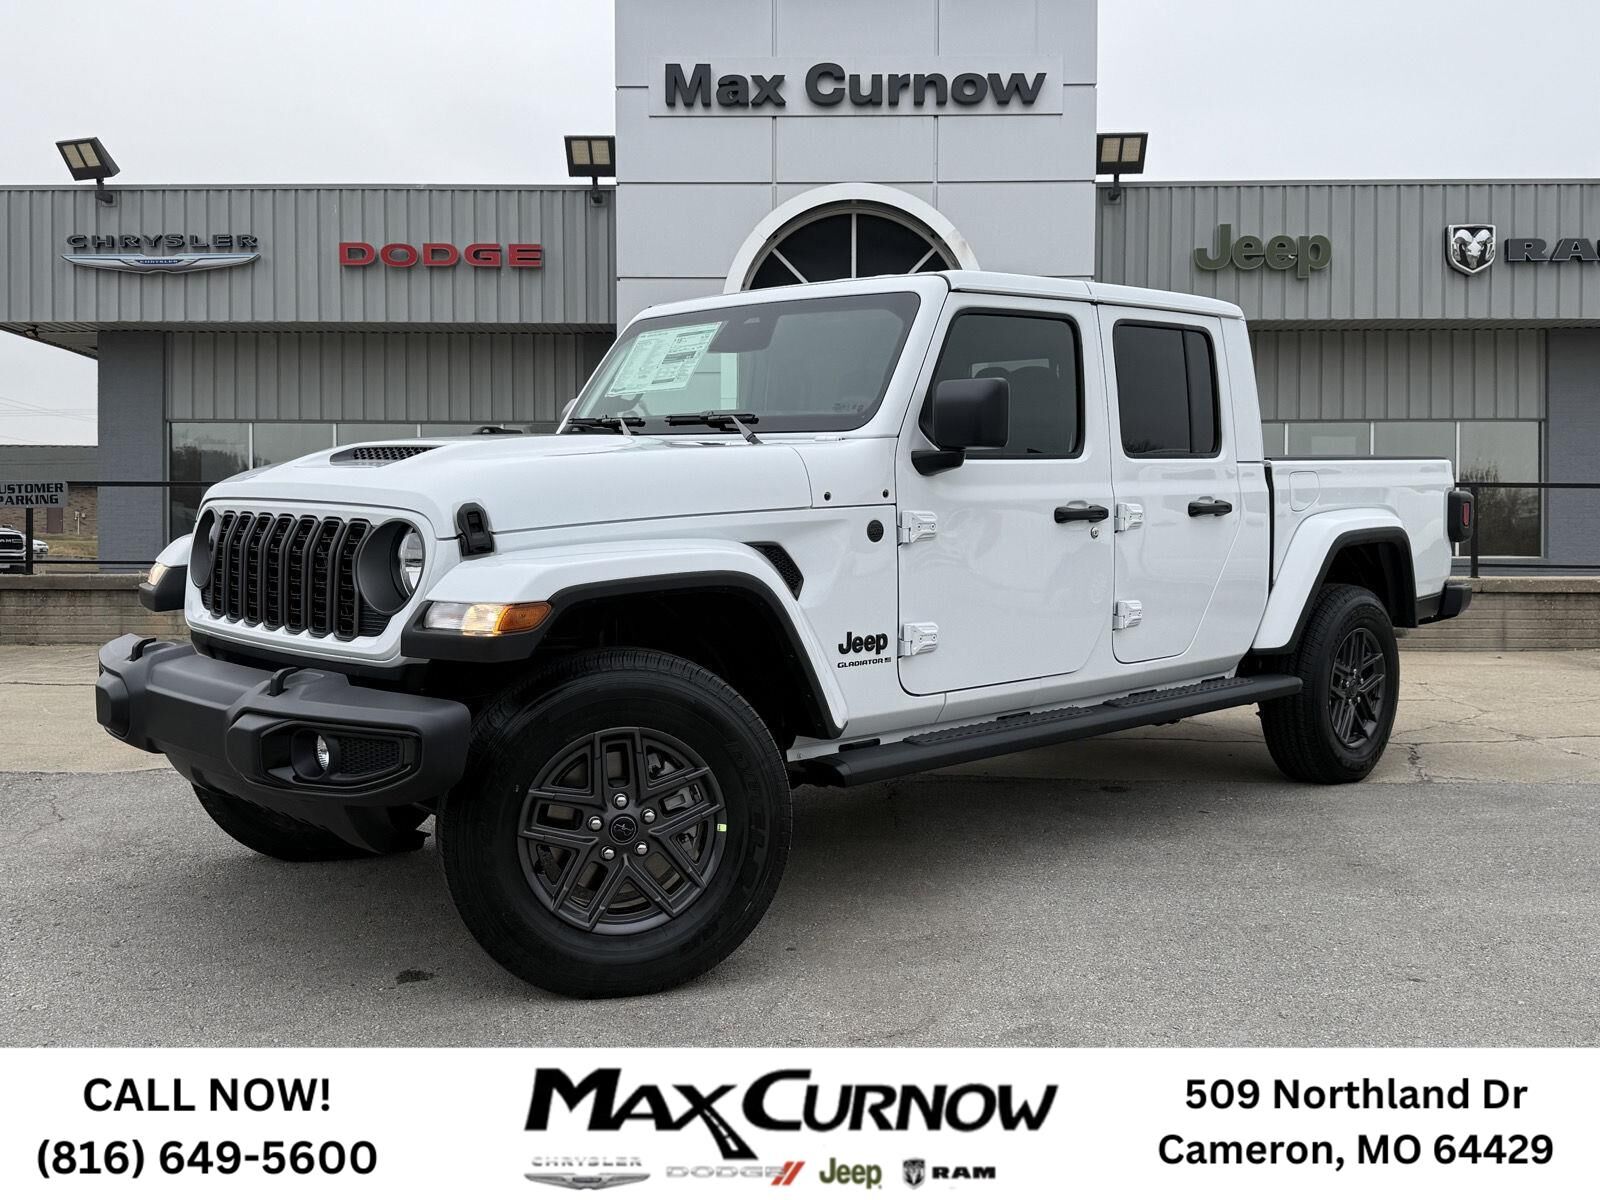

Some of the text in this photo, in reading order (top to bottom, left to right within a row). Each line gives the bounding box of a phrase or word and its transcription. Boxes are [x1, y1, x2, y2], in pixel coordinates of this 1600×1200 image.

[664, 62, 1047, 108] Max Curnow
[66, 234, 260, 249] CHRYSLER
[1193, 223, 1333, 279] Jeep
[1503, 238, 1600, 263] RA
[338, 242, 543, 268] DODGE
[0, 483, 64, 494] USTOMER
[838, 631, 888, 655] Jeep
[837, 657, 884, 669] GLADIATOR
